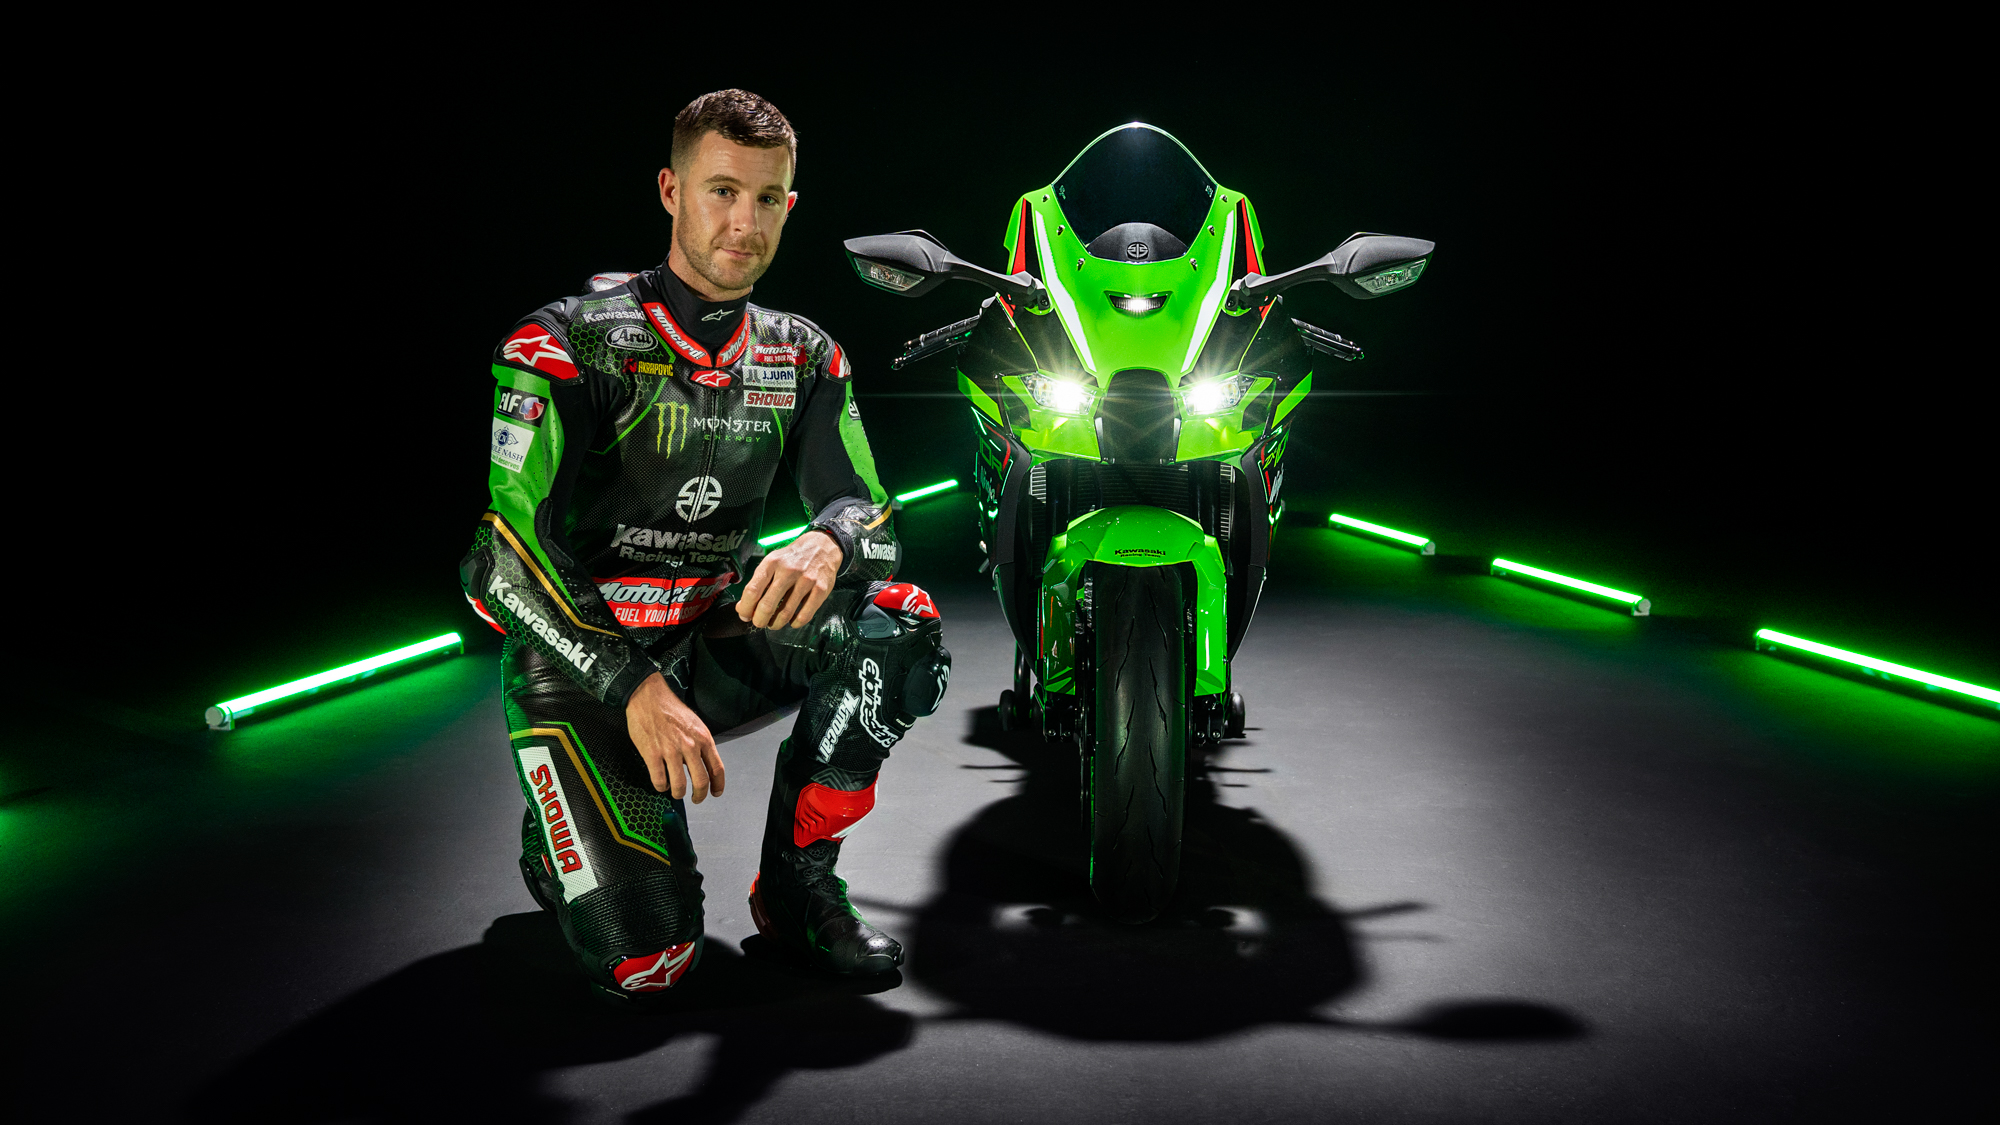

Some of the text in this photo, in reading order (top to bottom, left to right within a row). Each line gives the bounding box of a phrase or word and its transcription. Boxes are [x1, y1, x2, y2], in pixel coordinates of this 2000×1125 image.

[611, 328, 652, 345] Arai
[745, 392, 795, 407] SHOWA
[693, 416, 772, 434] MONSTER
[502, 448, 524, 462] NASH
[610, 523, 748, 552] Kawasaki
[619, 545, 684, 568] Racing
[1114, 548, 1166, 556] Kawasaki
[615, 607, 640, 622] FUEL
[488, 575, 598, 673] Kawasaki
[530, 764, 583, 874] SHOWA
